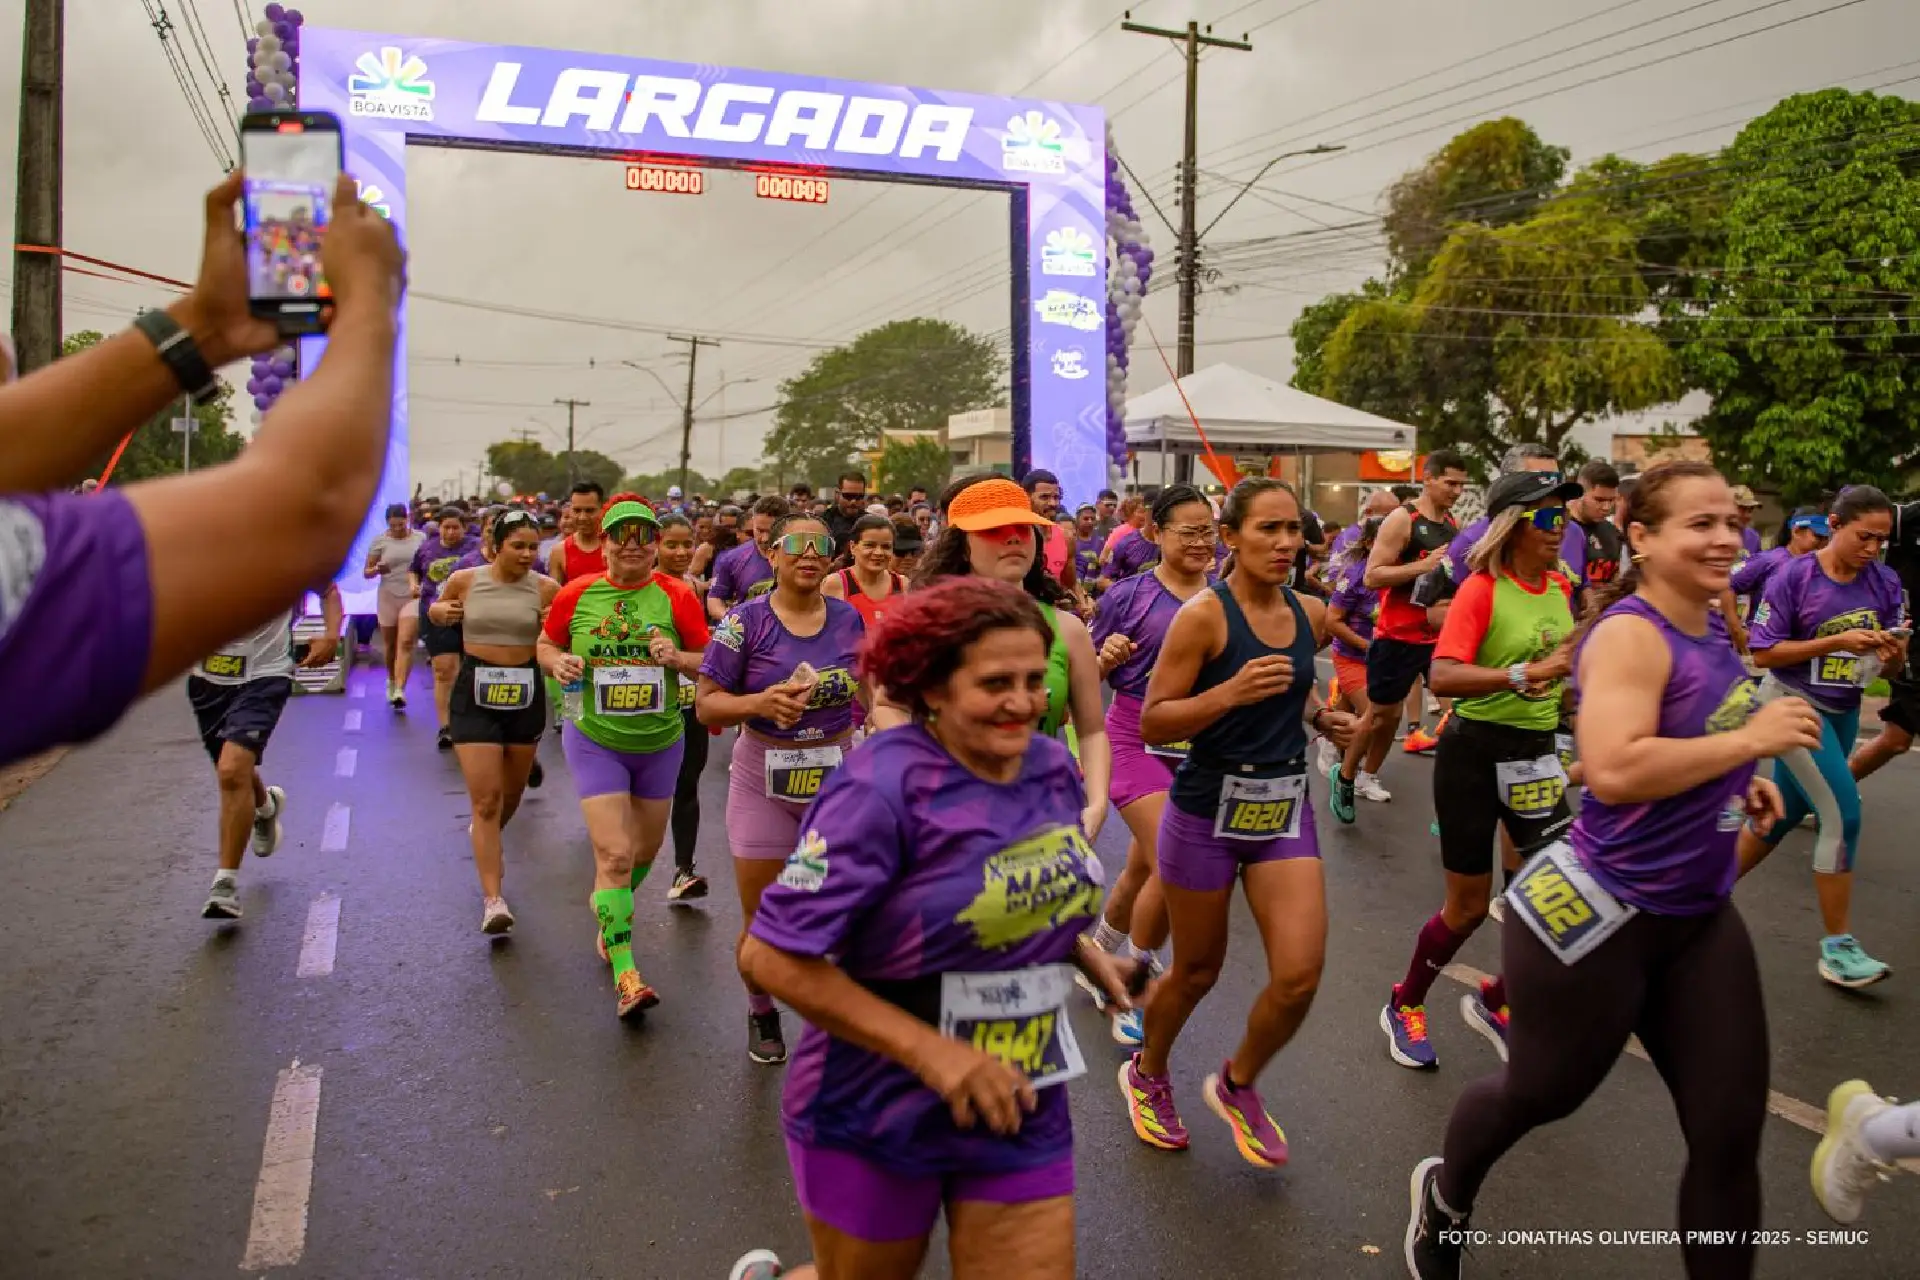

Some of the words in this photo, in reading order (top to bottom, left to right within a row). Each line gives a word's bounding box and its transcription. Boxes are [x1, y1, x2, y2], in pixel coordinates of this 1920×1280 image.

[476, 62, 974, 162] LARGADA
[487, 683, 521, 705] 1163
[606, 684, 653, 709] 1968
[785, 769, 824, 795] 1116
[1230, 800, 1291, 830] 1820
[1519, 863, 1593, 935] 1402
